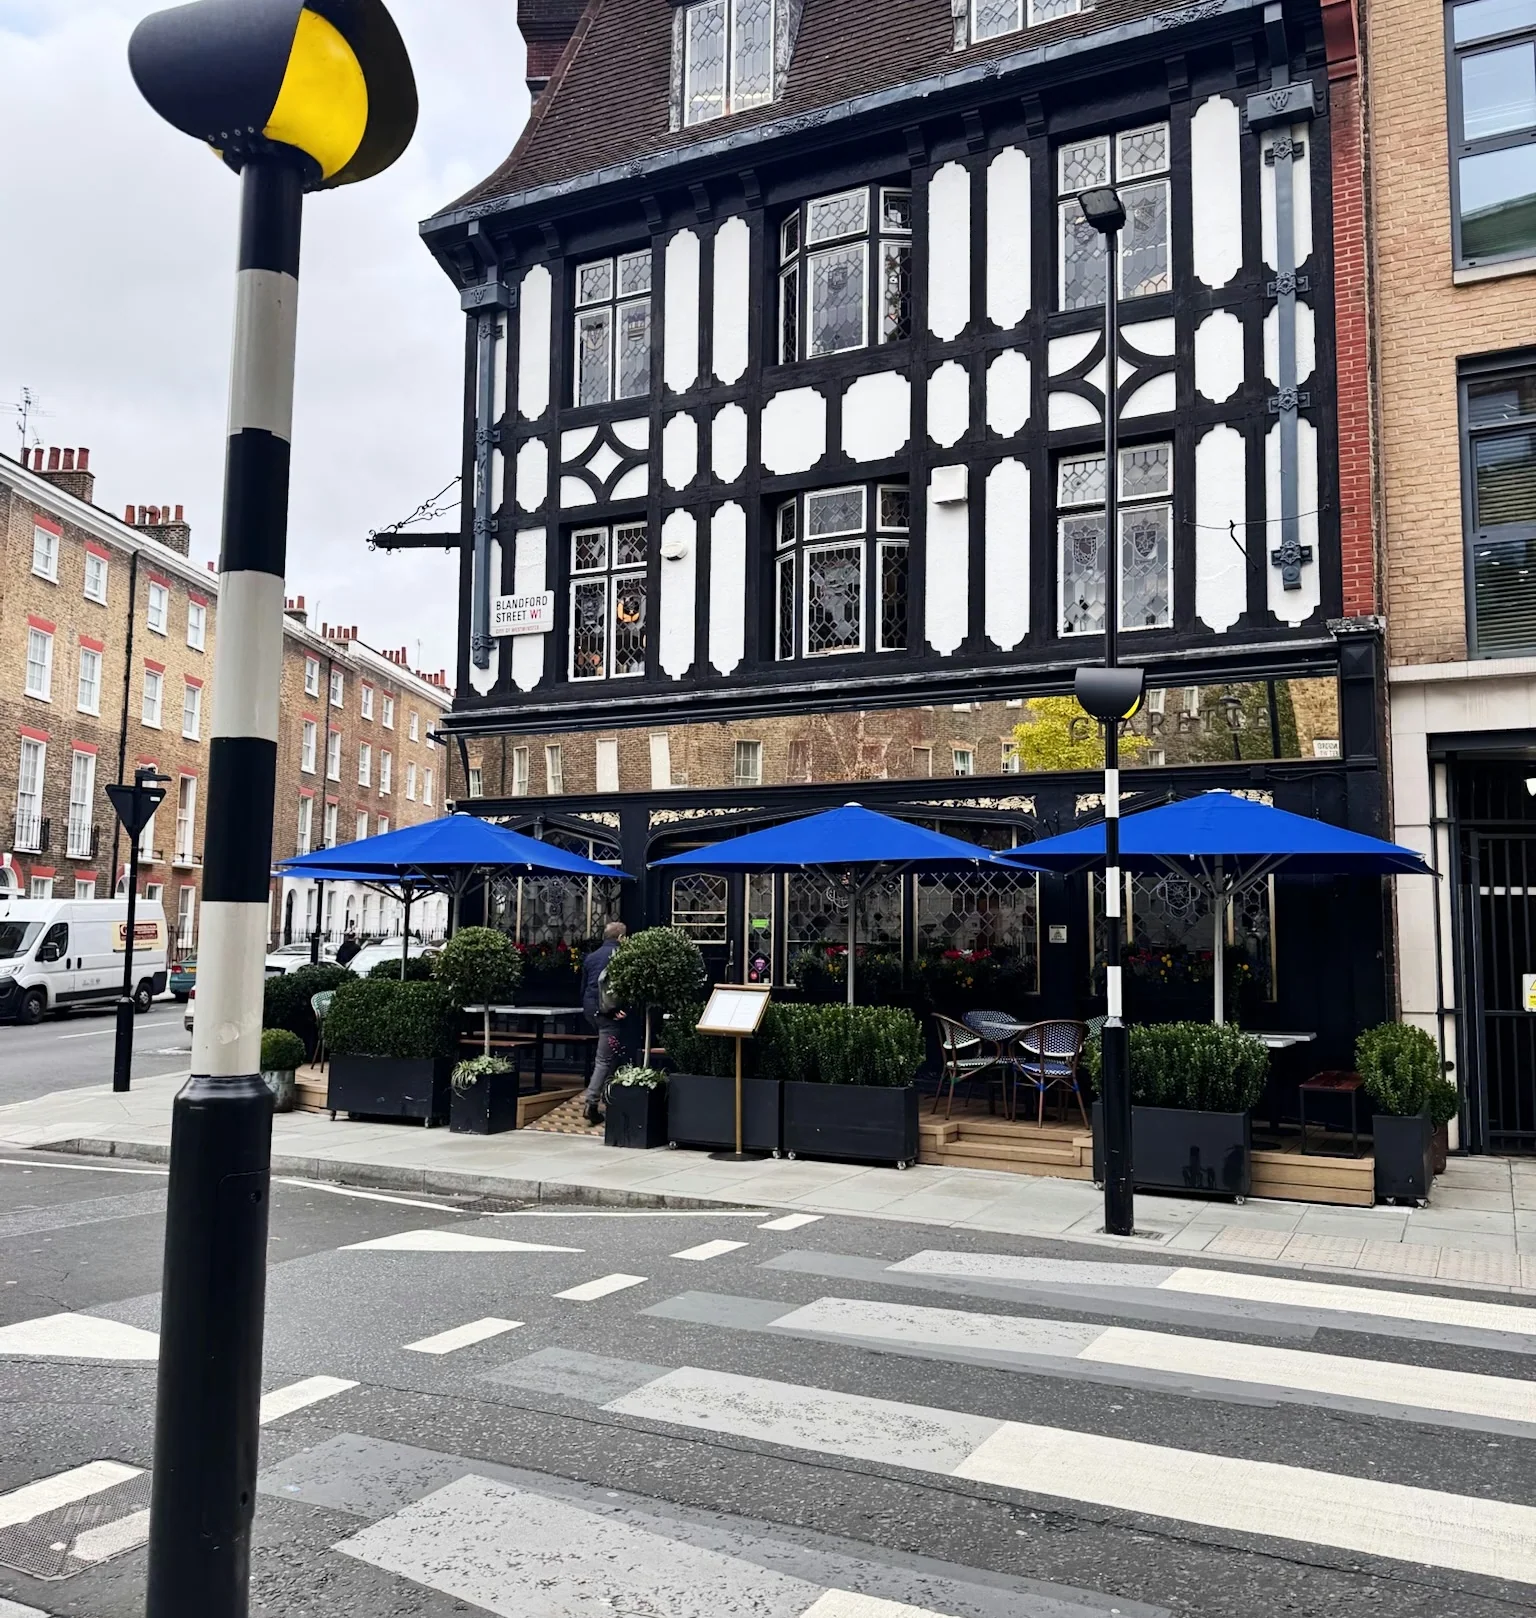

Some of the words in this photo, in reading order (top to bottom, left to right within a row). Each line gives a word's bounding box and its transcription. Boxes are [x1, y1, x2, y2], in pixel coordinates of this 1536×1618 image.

[496, 596, 547, 610] BLANDFORD
[496, 610, 527, 622] STREET
[530, 609, 542, 619] W1
